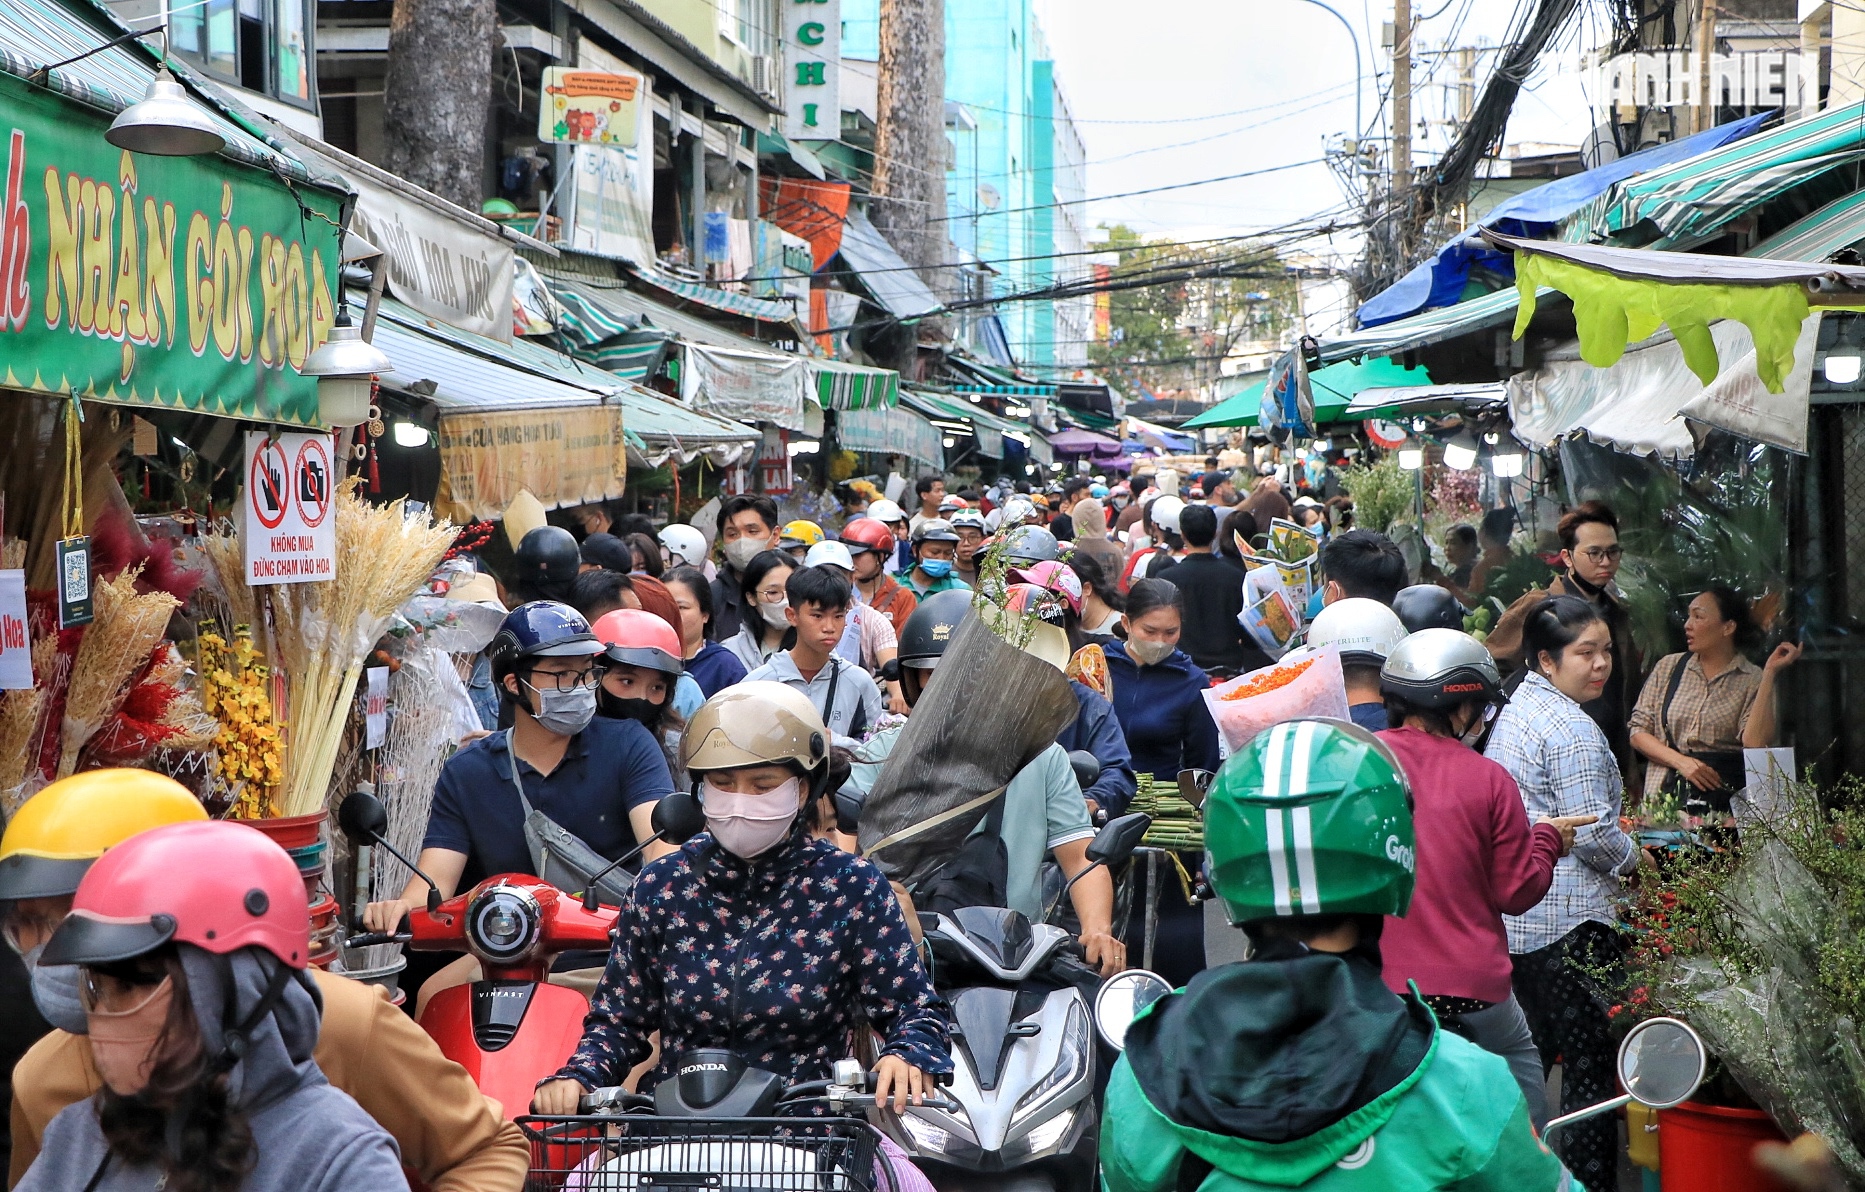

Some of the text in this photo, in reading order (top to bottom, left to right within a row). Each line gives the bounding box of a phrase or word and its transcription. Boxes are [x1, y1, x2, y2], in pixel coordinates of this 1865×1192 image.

[794, 0, 827, 127] CHI
[44, 150, 176, 384] NHẬN
[186, 181, 254, 364] GÓI
[260, 233, 335, 372] HOA
[419, 236, 460, 310] HOA
[460, 250, 495, 322] KHÔ
[271, 532, 314, 553] KHÔNG MUA
[253, 555, 331, 579] ĐỪNG CHẠM VÀO HOA
[3, 614, 25, 649] Hoa
[932, 633, 950, 641] Royal
[1443, 683, 1484, 693] HONDA
[1385, 835, 1413, 874] Grab
[680, 1063, 728, 1076] HONDA
